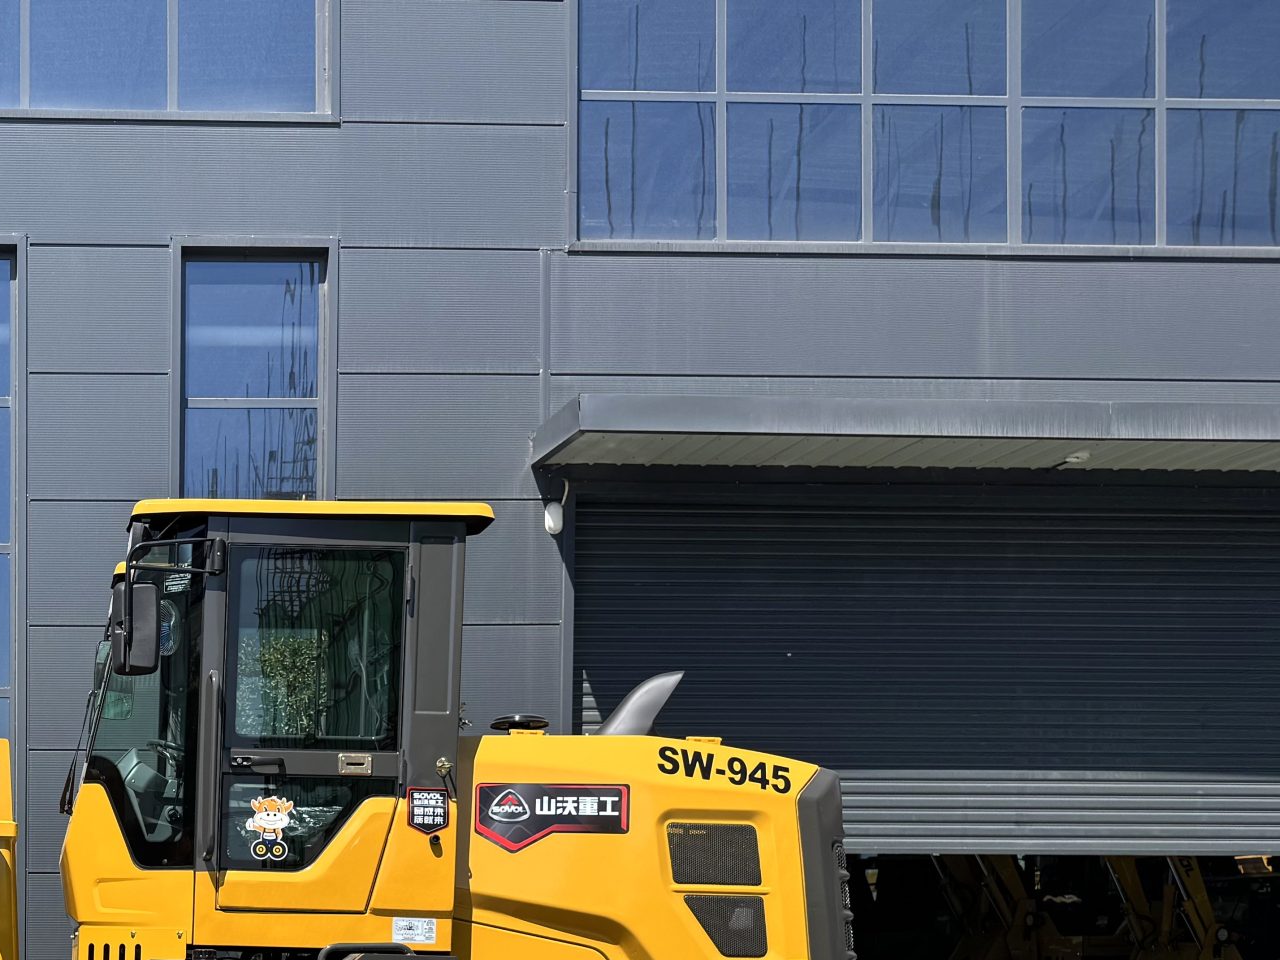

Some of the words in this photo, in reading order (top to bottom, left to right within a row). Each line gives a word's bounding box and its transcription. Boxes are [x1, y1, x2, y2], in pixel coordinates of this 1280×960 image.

[657, 746, 791, 794] SW-945
[535, 796, 619, 816] 山沃重工
